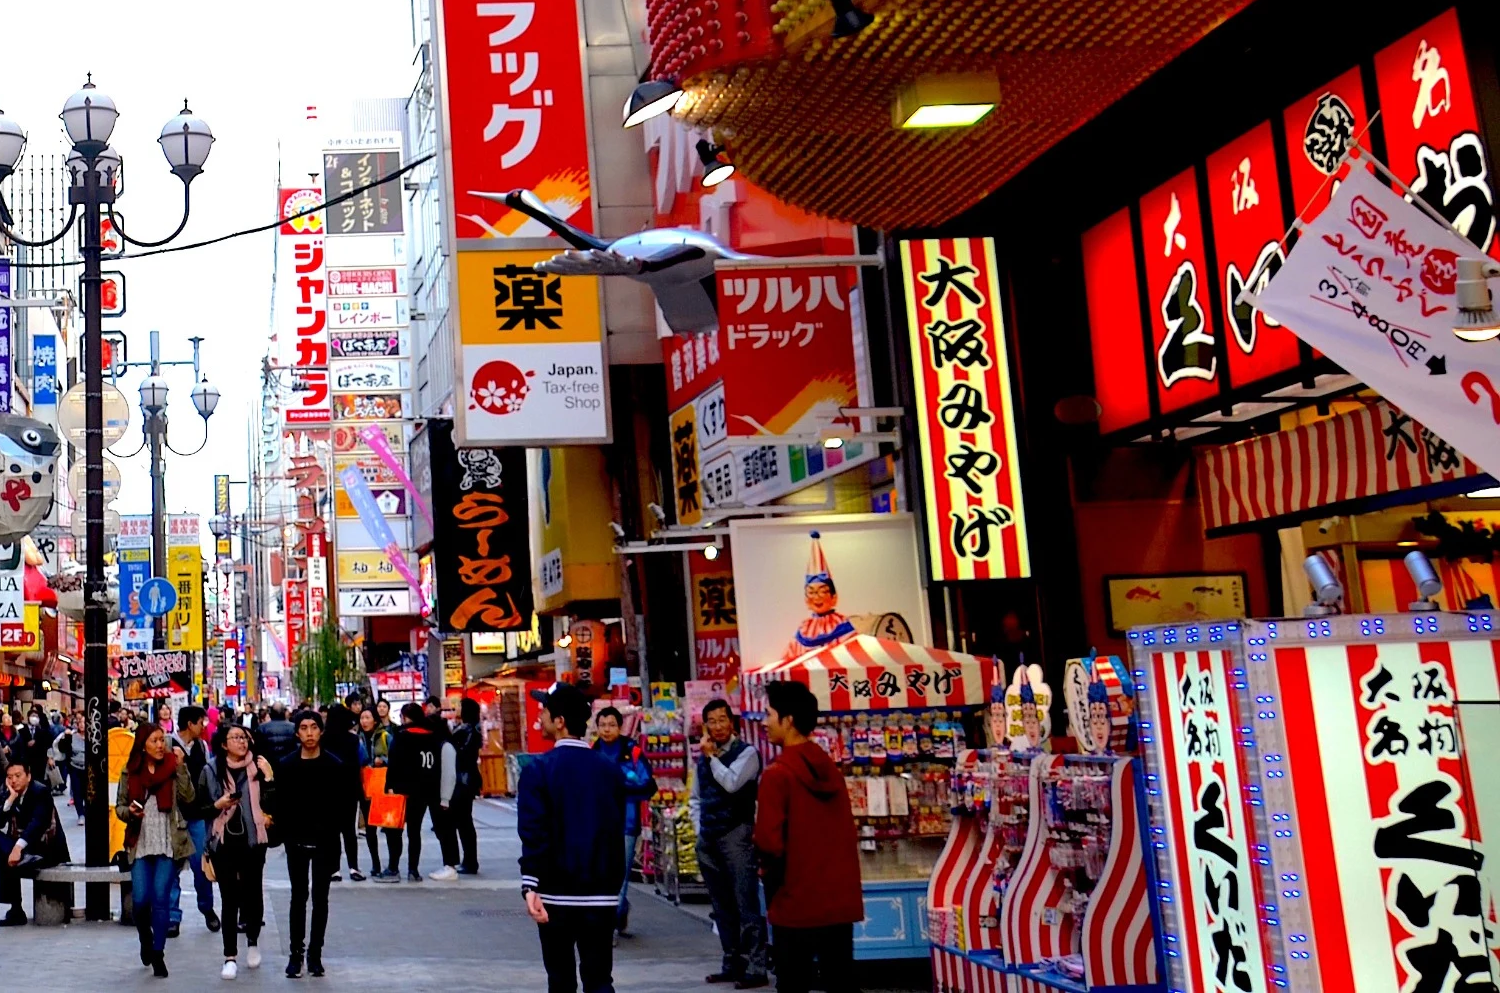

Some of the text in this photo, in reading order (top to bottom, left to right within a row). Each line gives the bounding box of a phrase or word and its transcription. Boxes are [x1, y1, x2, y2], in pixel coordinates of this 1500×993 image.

[492, 264, 564, 332] 薬
[722, 275, 845, 315] ツルハ
[294, 239, 329, 407] ジャンカラ
[338, 311, 393, 325] レインボー
[726, 321, 825, 350] ドラッグ
[33, 345, 56, 394] 焼肉
[547, 362, 599, 379] Japan.
[541, 381, 600, 394] Tax-free
[564, 396, 601, 412] Shop
[919, 257, 1015, 561] 大阪みやげ
[449, 491, 523, 631] らーめん
[350, 593, 397, 608] ZAZA
[1, 628, 23, 643] 2F
[830, 667, 963, 699] 大阪みやげ
[1365, 665, 1452, 704] 大阪
[1371, 716, 1461, 758] 名物
